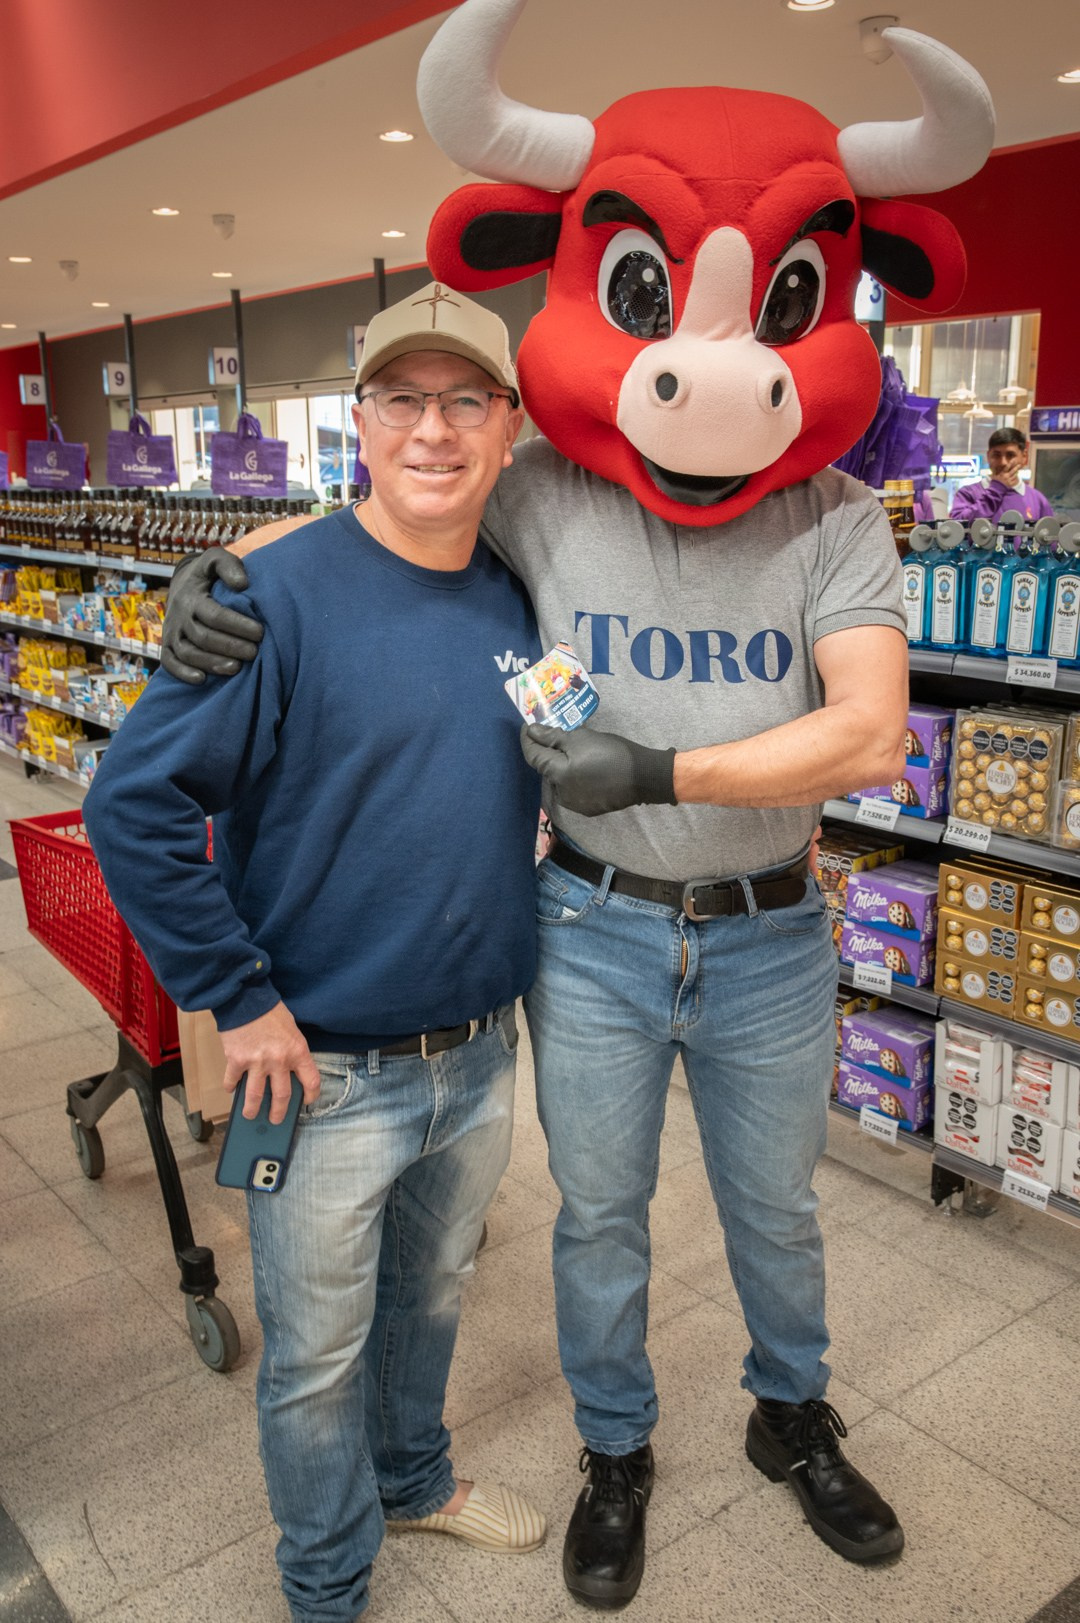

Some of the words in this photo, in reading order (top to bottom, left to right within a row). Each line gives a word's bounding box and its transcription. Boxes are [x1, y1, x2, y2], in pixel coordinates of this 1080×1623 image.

[215, 357, 238, 375] 10
[115, 371, 125, 386] 9
[30, 383, 40, 396] 8
[1058, 411, 1080, 429] HI
[133, 464, 162, 474] Gallega
[229, 471, 240, 480] La
[240, 472, 273, 482] Gallega
[1017, 578, 1034, 588] BOMBAY
[1061, 581, 1079, 591] BOMBAY
[575, 611, 793, 684] TORO
[954, 826, 988, 842] 20,299.00
[853, 890, 888, 910] Milka
[848, 935, 884, 954] Milka
[848, 1034, 880, 1053] Milka
[844, 1078, 880, 1097] Milka
